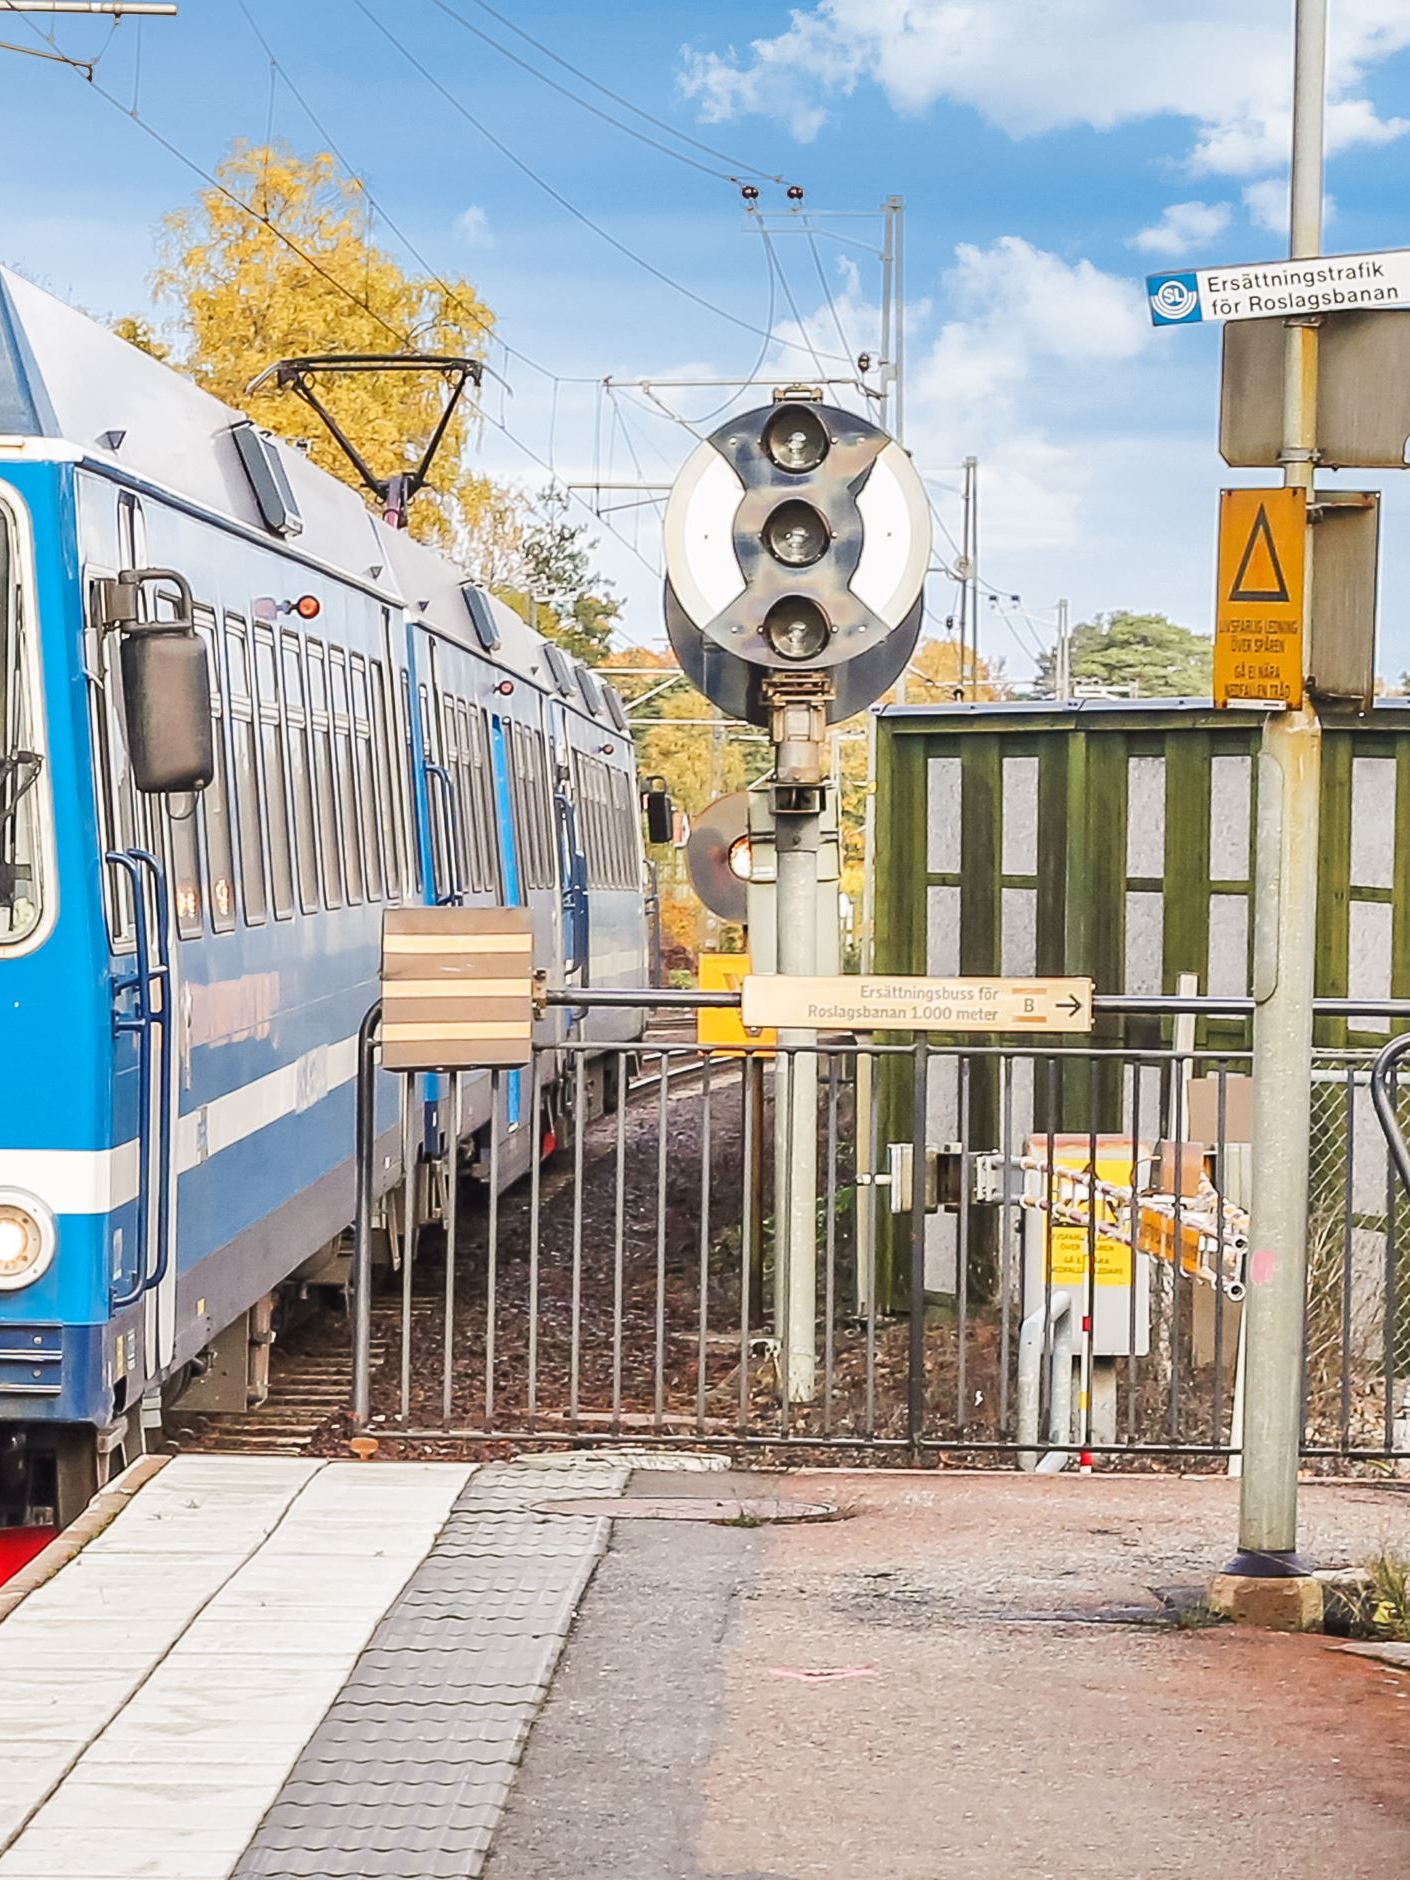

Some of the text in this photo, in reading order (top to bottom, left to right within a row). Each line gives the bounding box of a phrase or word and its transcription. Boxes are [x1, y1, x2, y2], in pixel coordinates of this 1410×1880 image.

[1207, 260, 1384, 293] Ersättningstrafik
[1164, 288, 1184, 304] SL
[1211, 286, 1399, 316] för Roslagsbanan
[860, 985, 1000, 1002] Ersättningsbuss för
[808, 1004, 1000, 1021] Roslagsbanan 1.000 meter
[1023, 998, 1035, 1013] B
